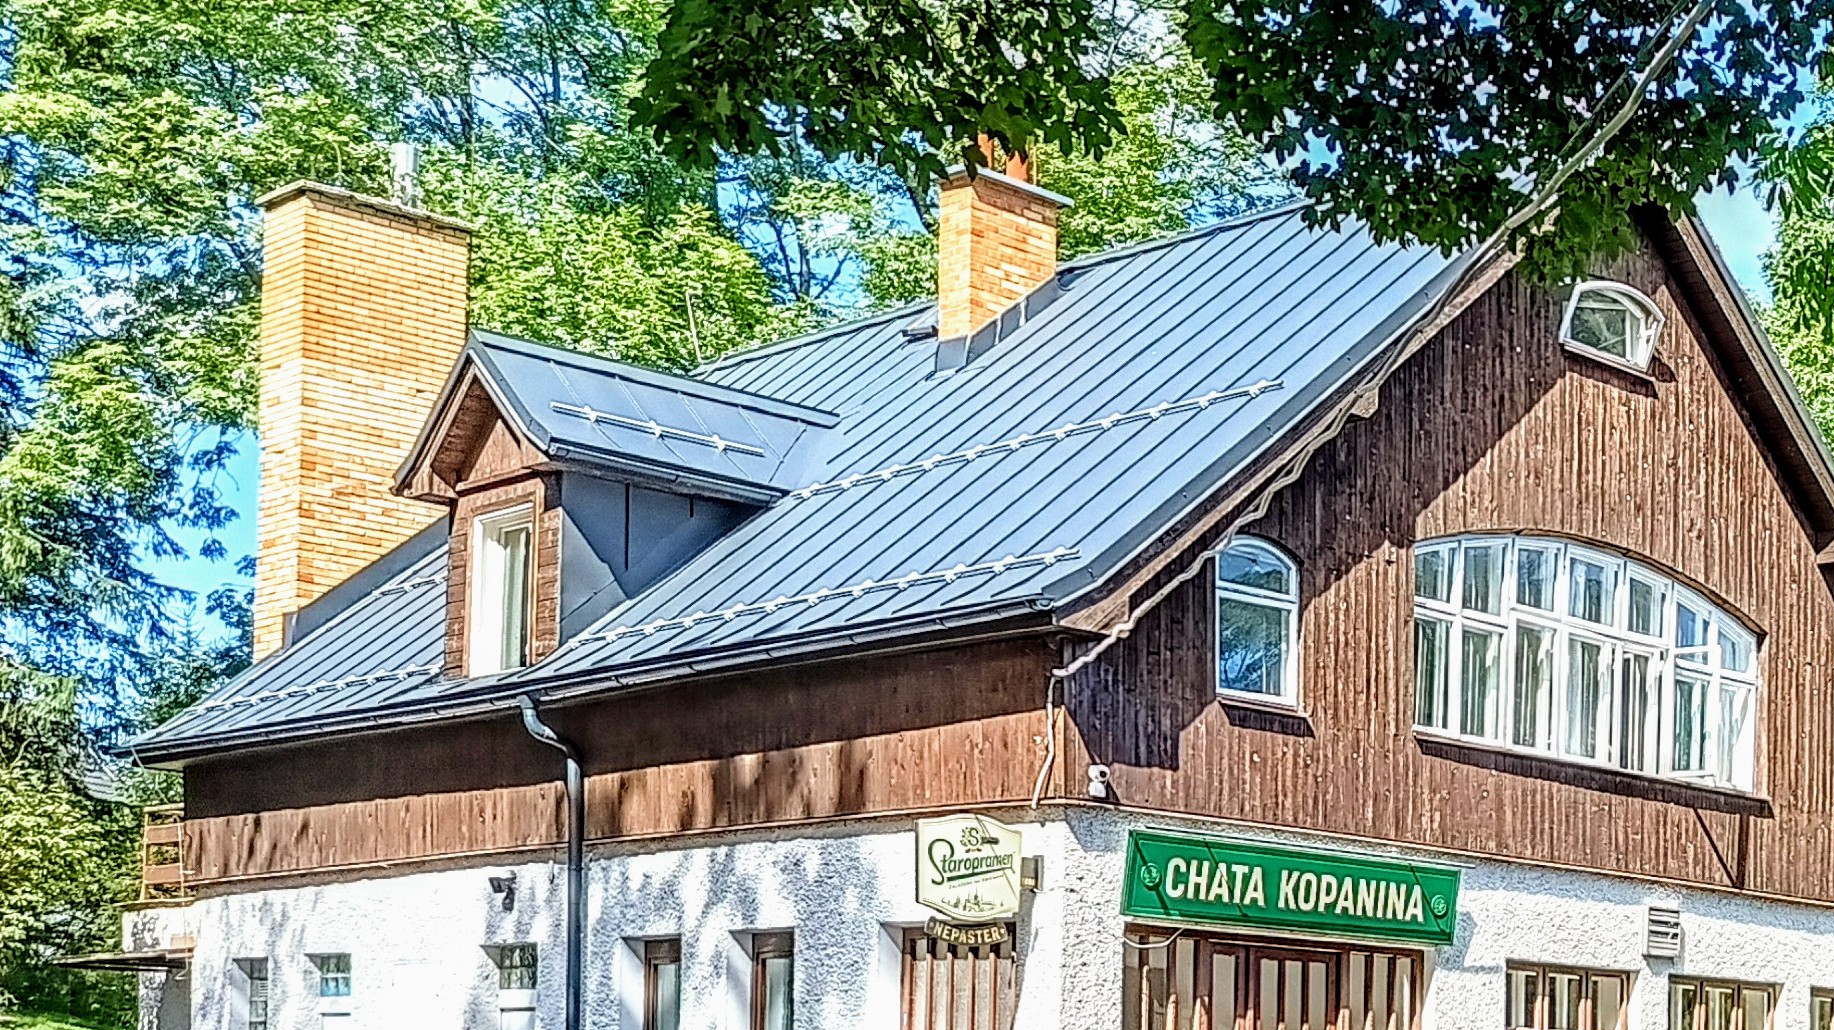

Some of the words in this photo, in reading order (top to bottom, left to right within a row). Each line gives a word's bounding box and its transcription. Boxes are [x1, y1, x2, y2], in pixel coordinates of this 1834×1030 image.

[927, 838, 1016, 886] Staropramen
[1165, 857, 1266, 907] CHATA
[1277, 869, 1425, 923] KOPANINA
[933, 921, 1001, 944] NEPASTER
